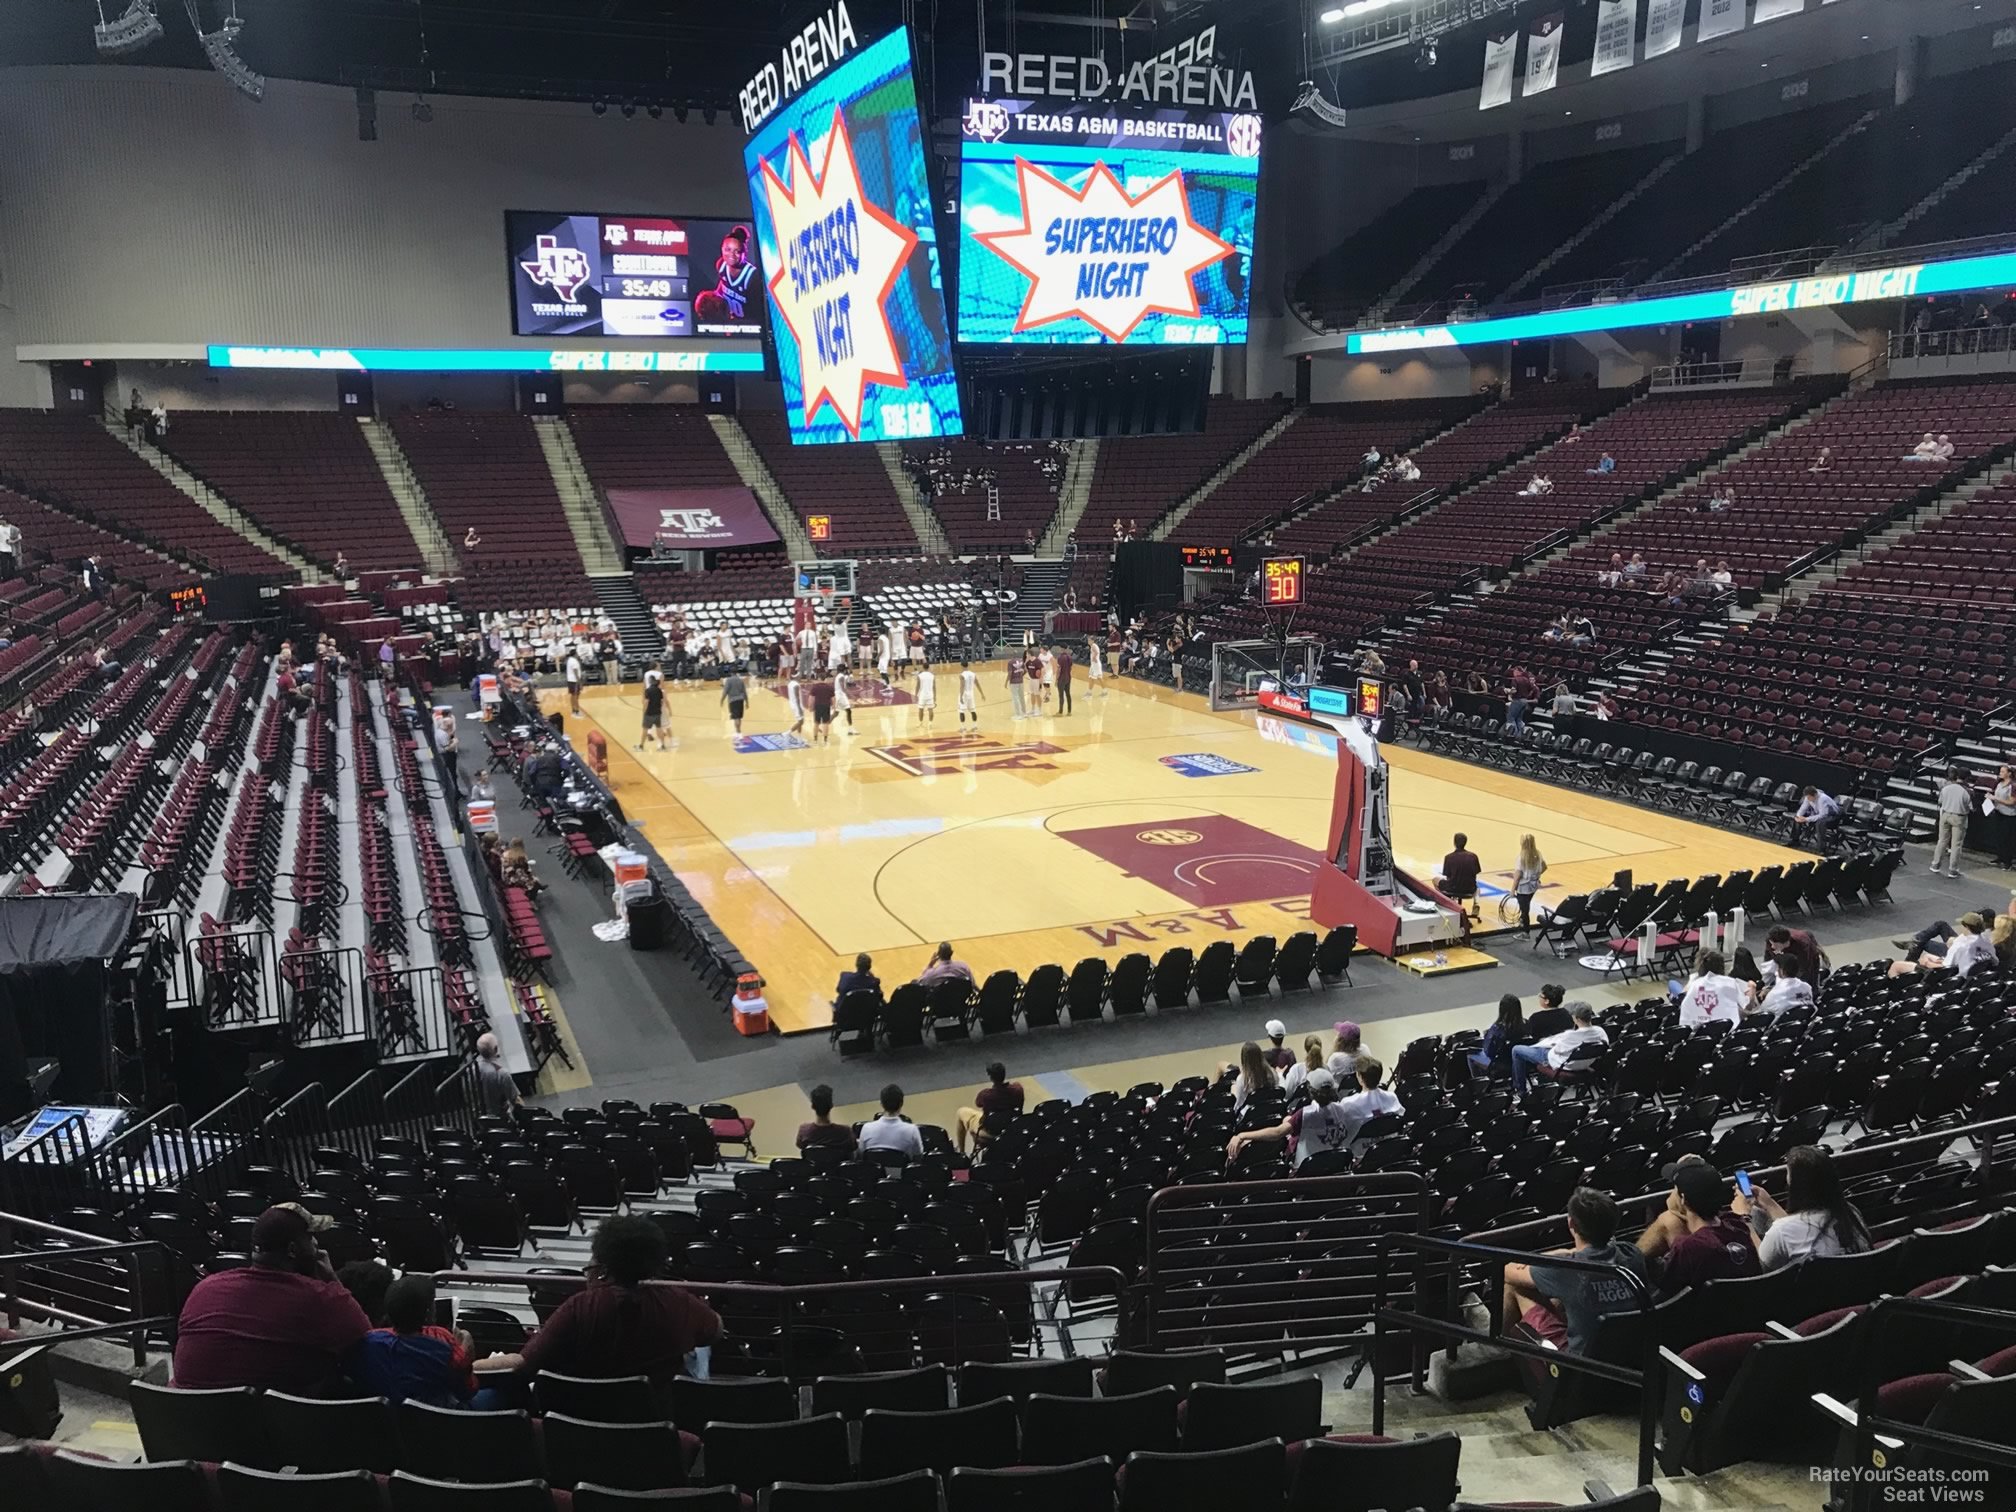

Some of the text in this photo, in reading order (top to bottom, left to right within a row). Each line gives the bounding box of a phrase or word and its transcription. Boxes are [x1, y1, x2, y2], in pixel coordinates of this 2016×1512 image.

[739, 0, 858, 135] REED ARENA
[982, 52, 1258, 110] REED ARENA
[1781, 81, 1808, 98] 203
[1015, 113, 1223, 141] TEXAS A&M BASKETBALL
[1231, 121, 1261, 155] SEC
[1596, 124, 1621, 140] 202
[1045, 216, 1178, 256] SUPERHERO
[790, 198, 860, 303] SUPERHERO
[622, 279, 671, 297] 35:49
[1075, 261, 1150, 300] NIGHT
[1731, 264, 1925, 316] SUPER HERO NIGHT
[531, 303, 563, 312] TEXAS
[813, 292, 855, 371] NIGHT
[811, 525, 827, 538] 30
[1266, 561, 1300, 577] 35:49
[1271, 577, 1295, 600] 30
[1364, 696, 1376, 713] 30
